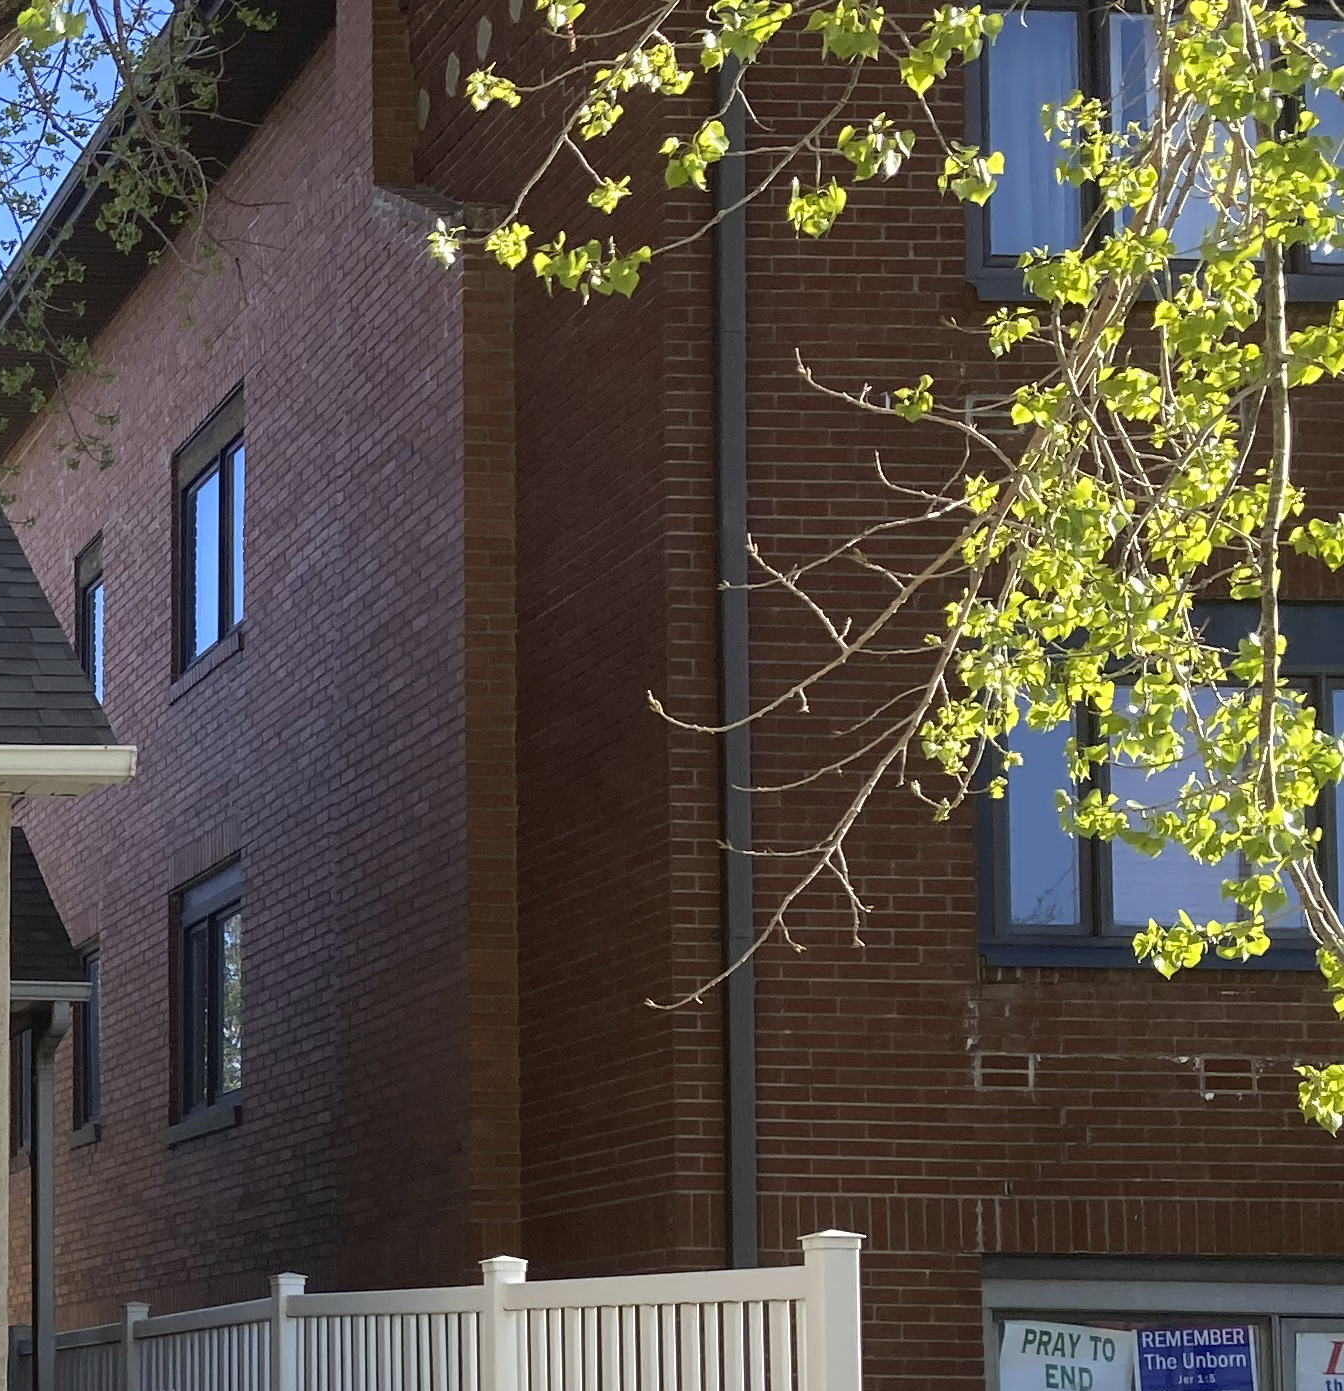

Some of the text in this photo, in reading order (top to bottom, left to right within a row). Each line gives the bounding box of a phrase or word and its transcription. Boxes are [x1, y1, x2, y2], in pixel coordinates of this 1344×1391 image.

[1021, 1328, 1116, 1362] PRAY TO
[1141, 1328, 1245, 1348] REMEMBER
[1143, 1352, 1247, 1371] The Unborn
[1045, 1364, 1093, 1391] END
